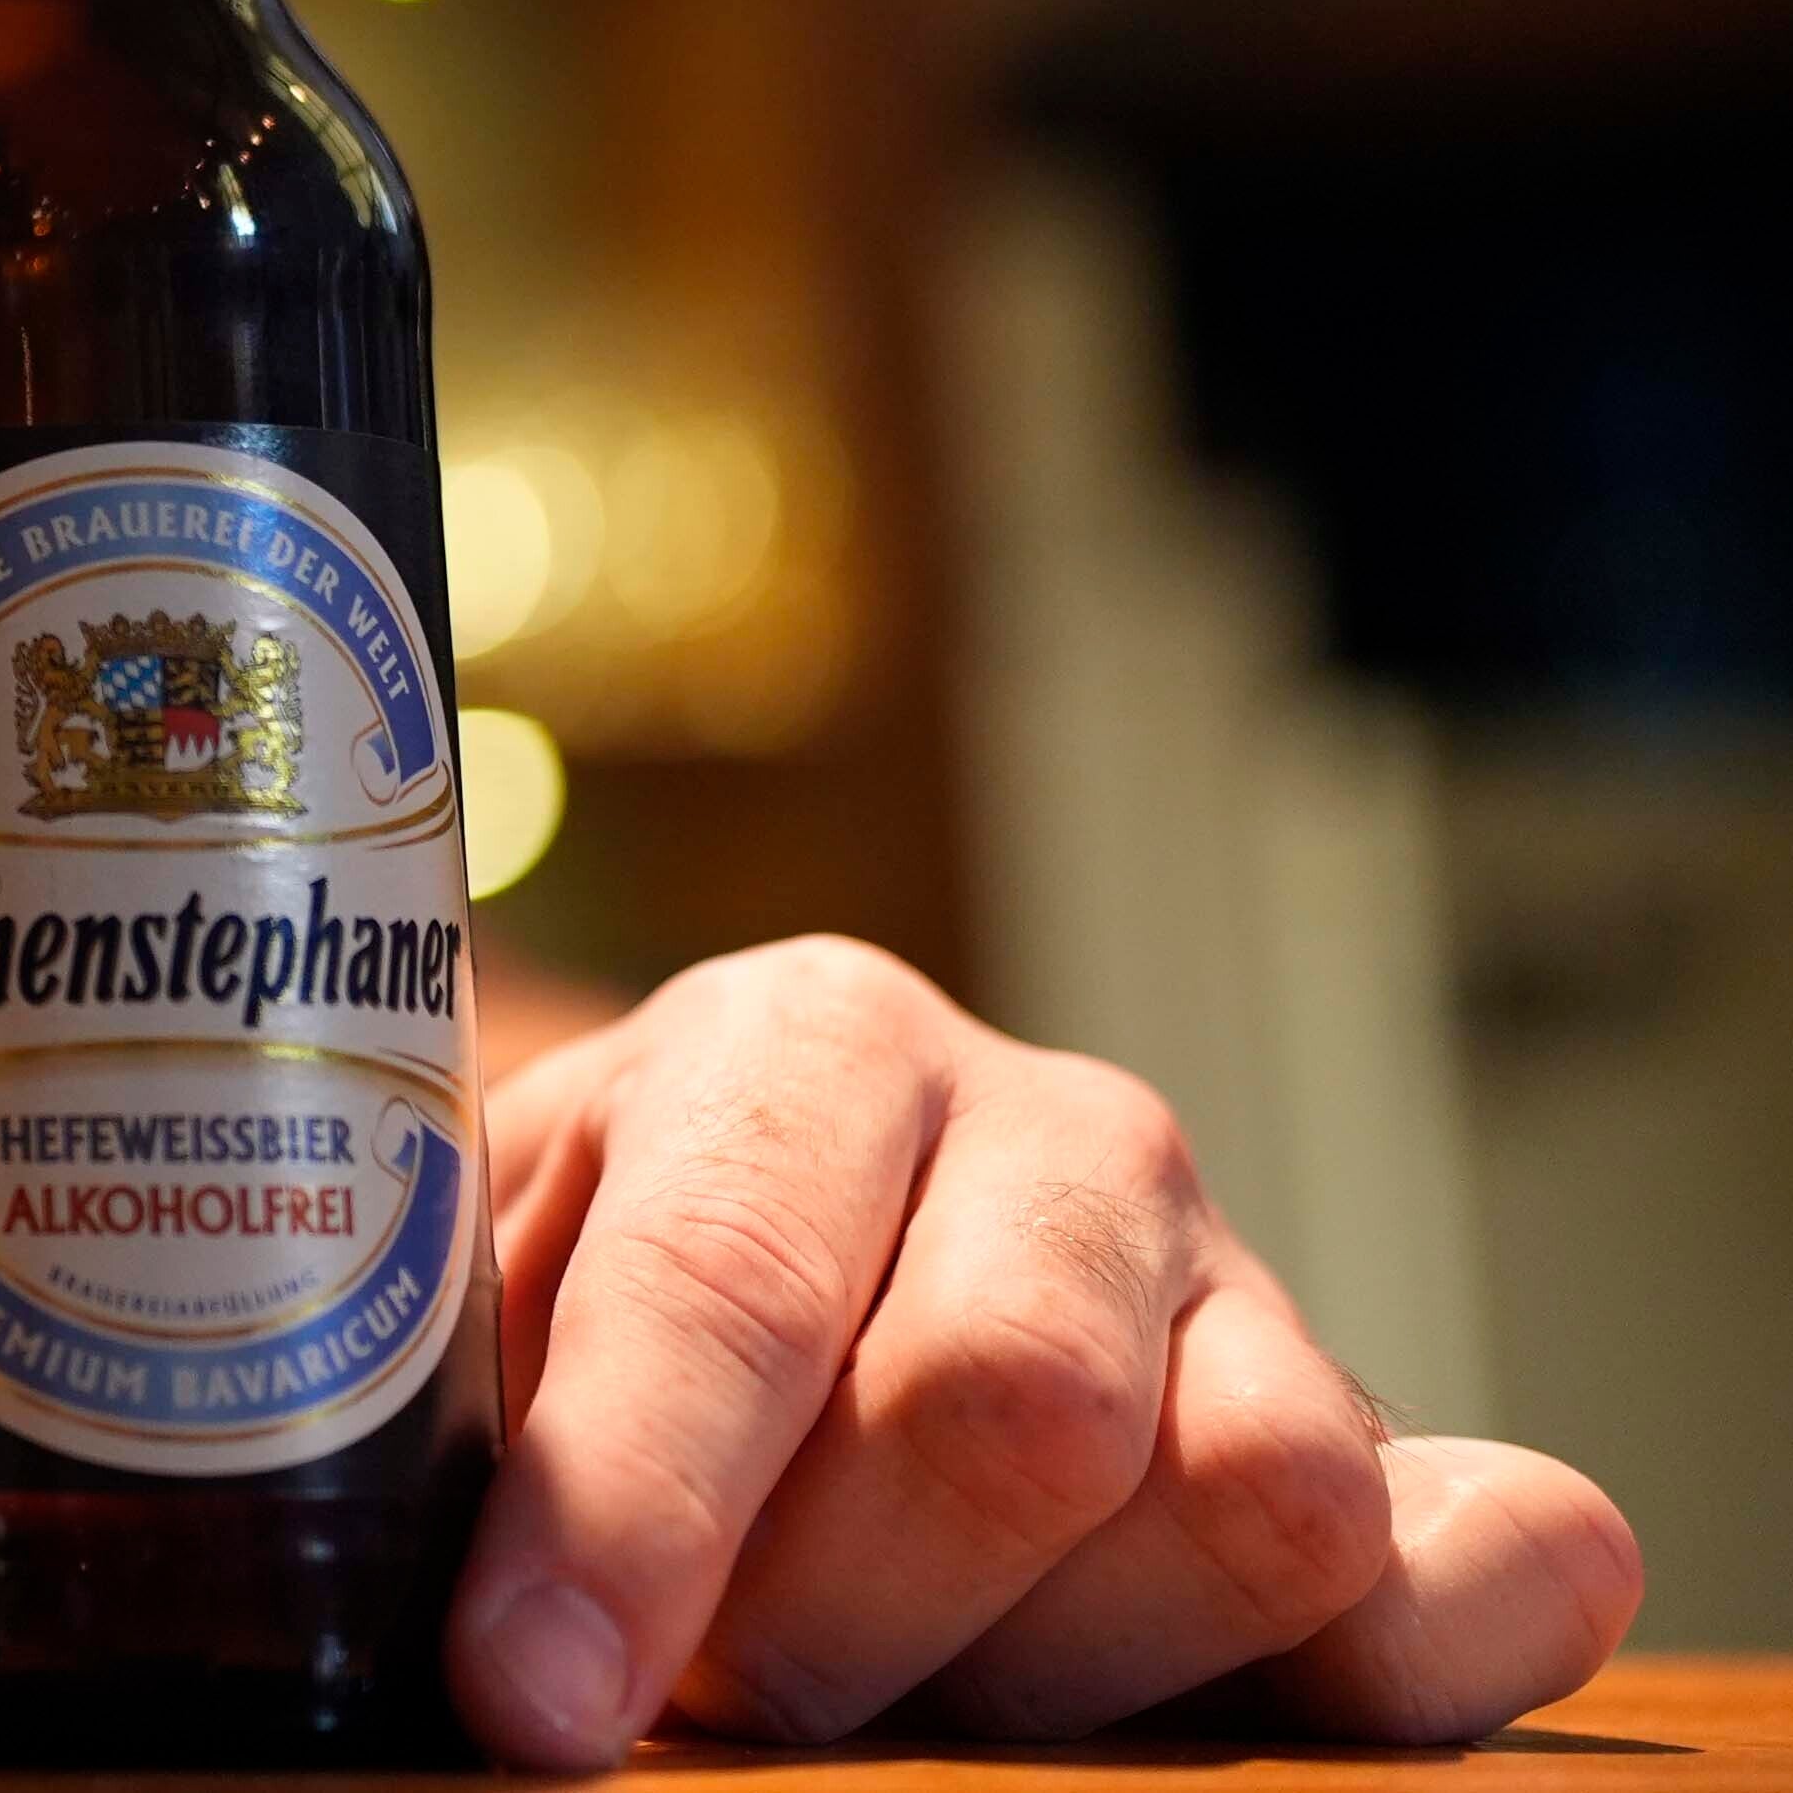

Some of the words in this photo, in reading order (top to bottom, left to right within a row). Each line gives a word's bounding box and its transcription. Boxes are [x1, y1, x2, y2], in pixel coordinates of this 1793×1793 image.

[21, 500, 255, 566] BRAUEREI
[267, 530, 341, 604] DER
[344, 594, 411, 703] WELT
[0, 1114, 356, 1167] HEFEWEISSBIER
[1, 1183, 356, 1238] ALKOHOLFREI
[171, 1266, 425, 1407] BAVARICUM
